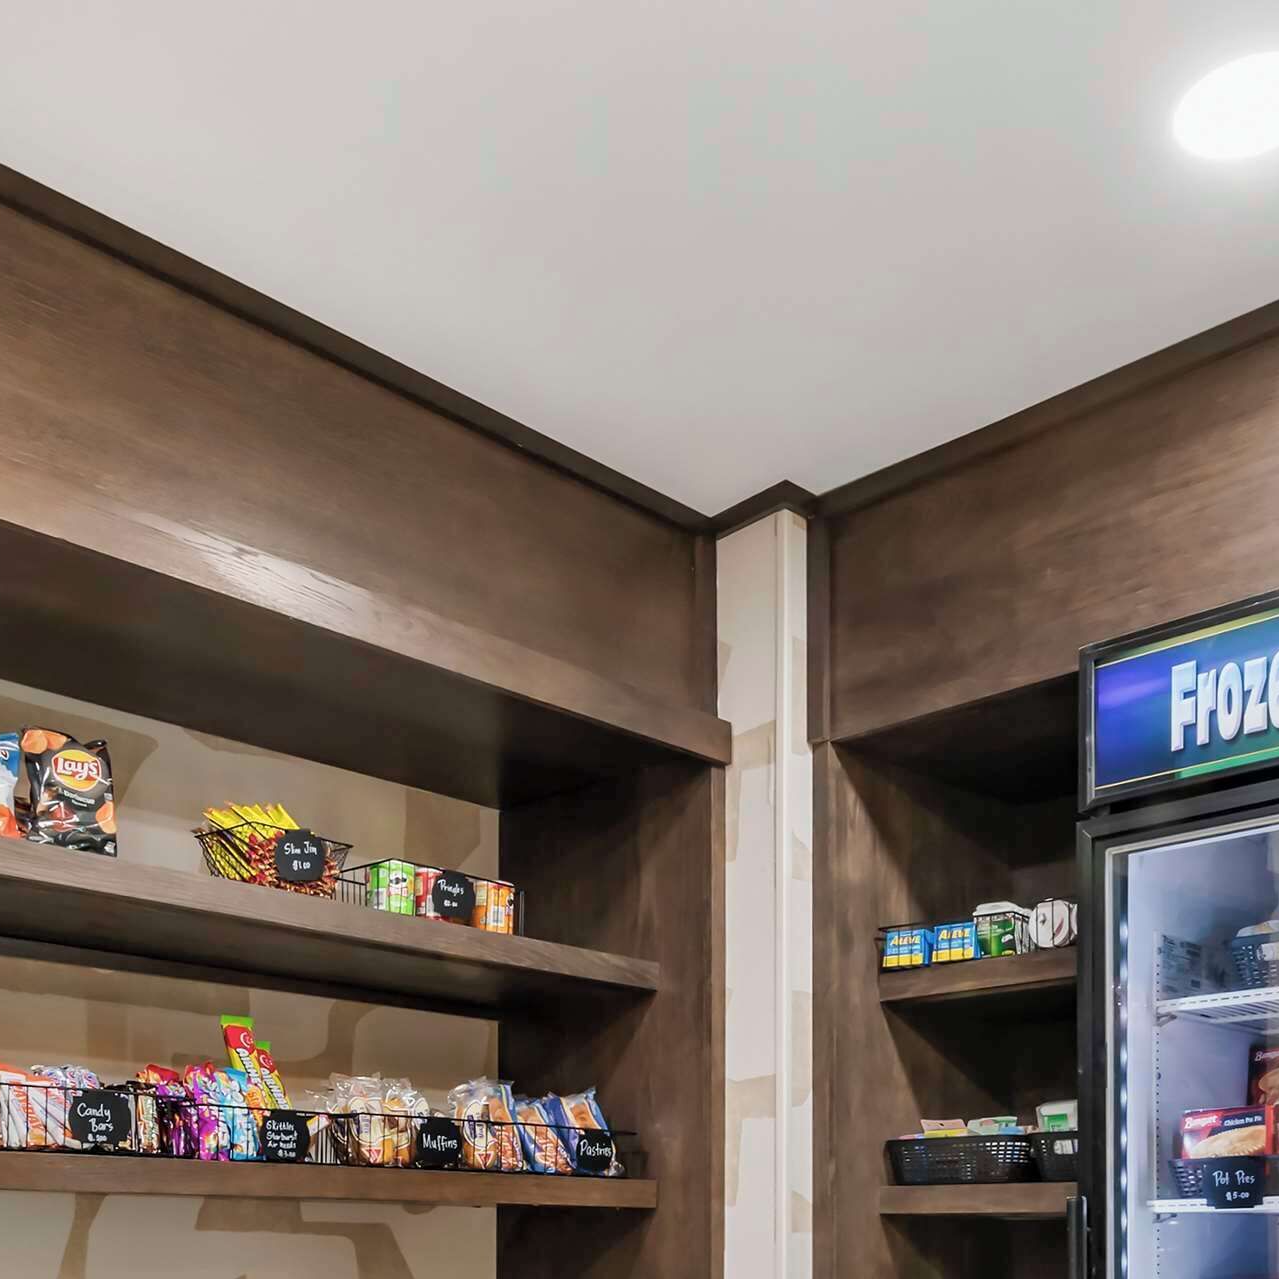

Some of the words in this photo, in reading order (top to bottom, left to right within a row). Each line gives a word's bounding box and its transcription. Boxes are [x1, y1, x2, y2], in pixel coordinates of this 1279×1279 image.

[303, 840, 318, 857] Jim
[76, 1102, 112, 1122] Candy
[89, 1118, 114, 1133] Bars
[1184, 1115, 1219, 1129] Banquet
[422, 1132, 458, 1152] Muffins
[579, 1138, 612, 1158] Pastries
[1212, 1170, 1229, 1186] Pot
[1234, 1170, 1256, 1185] Pies
